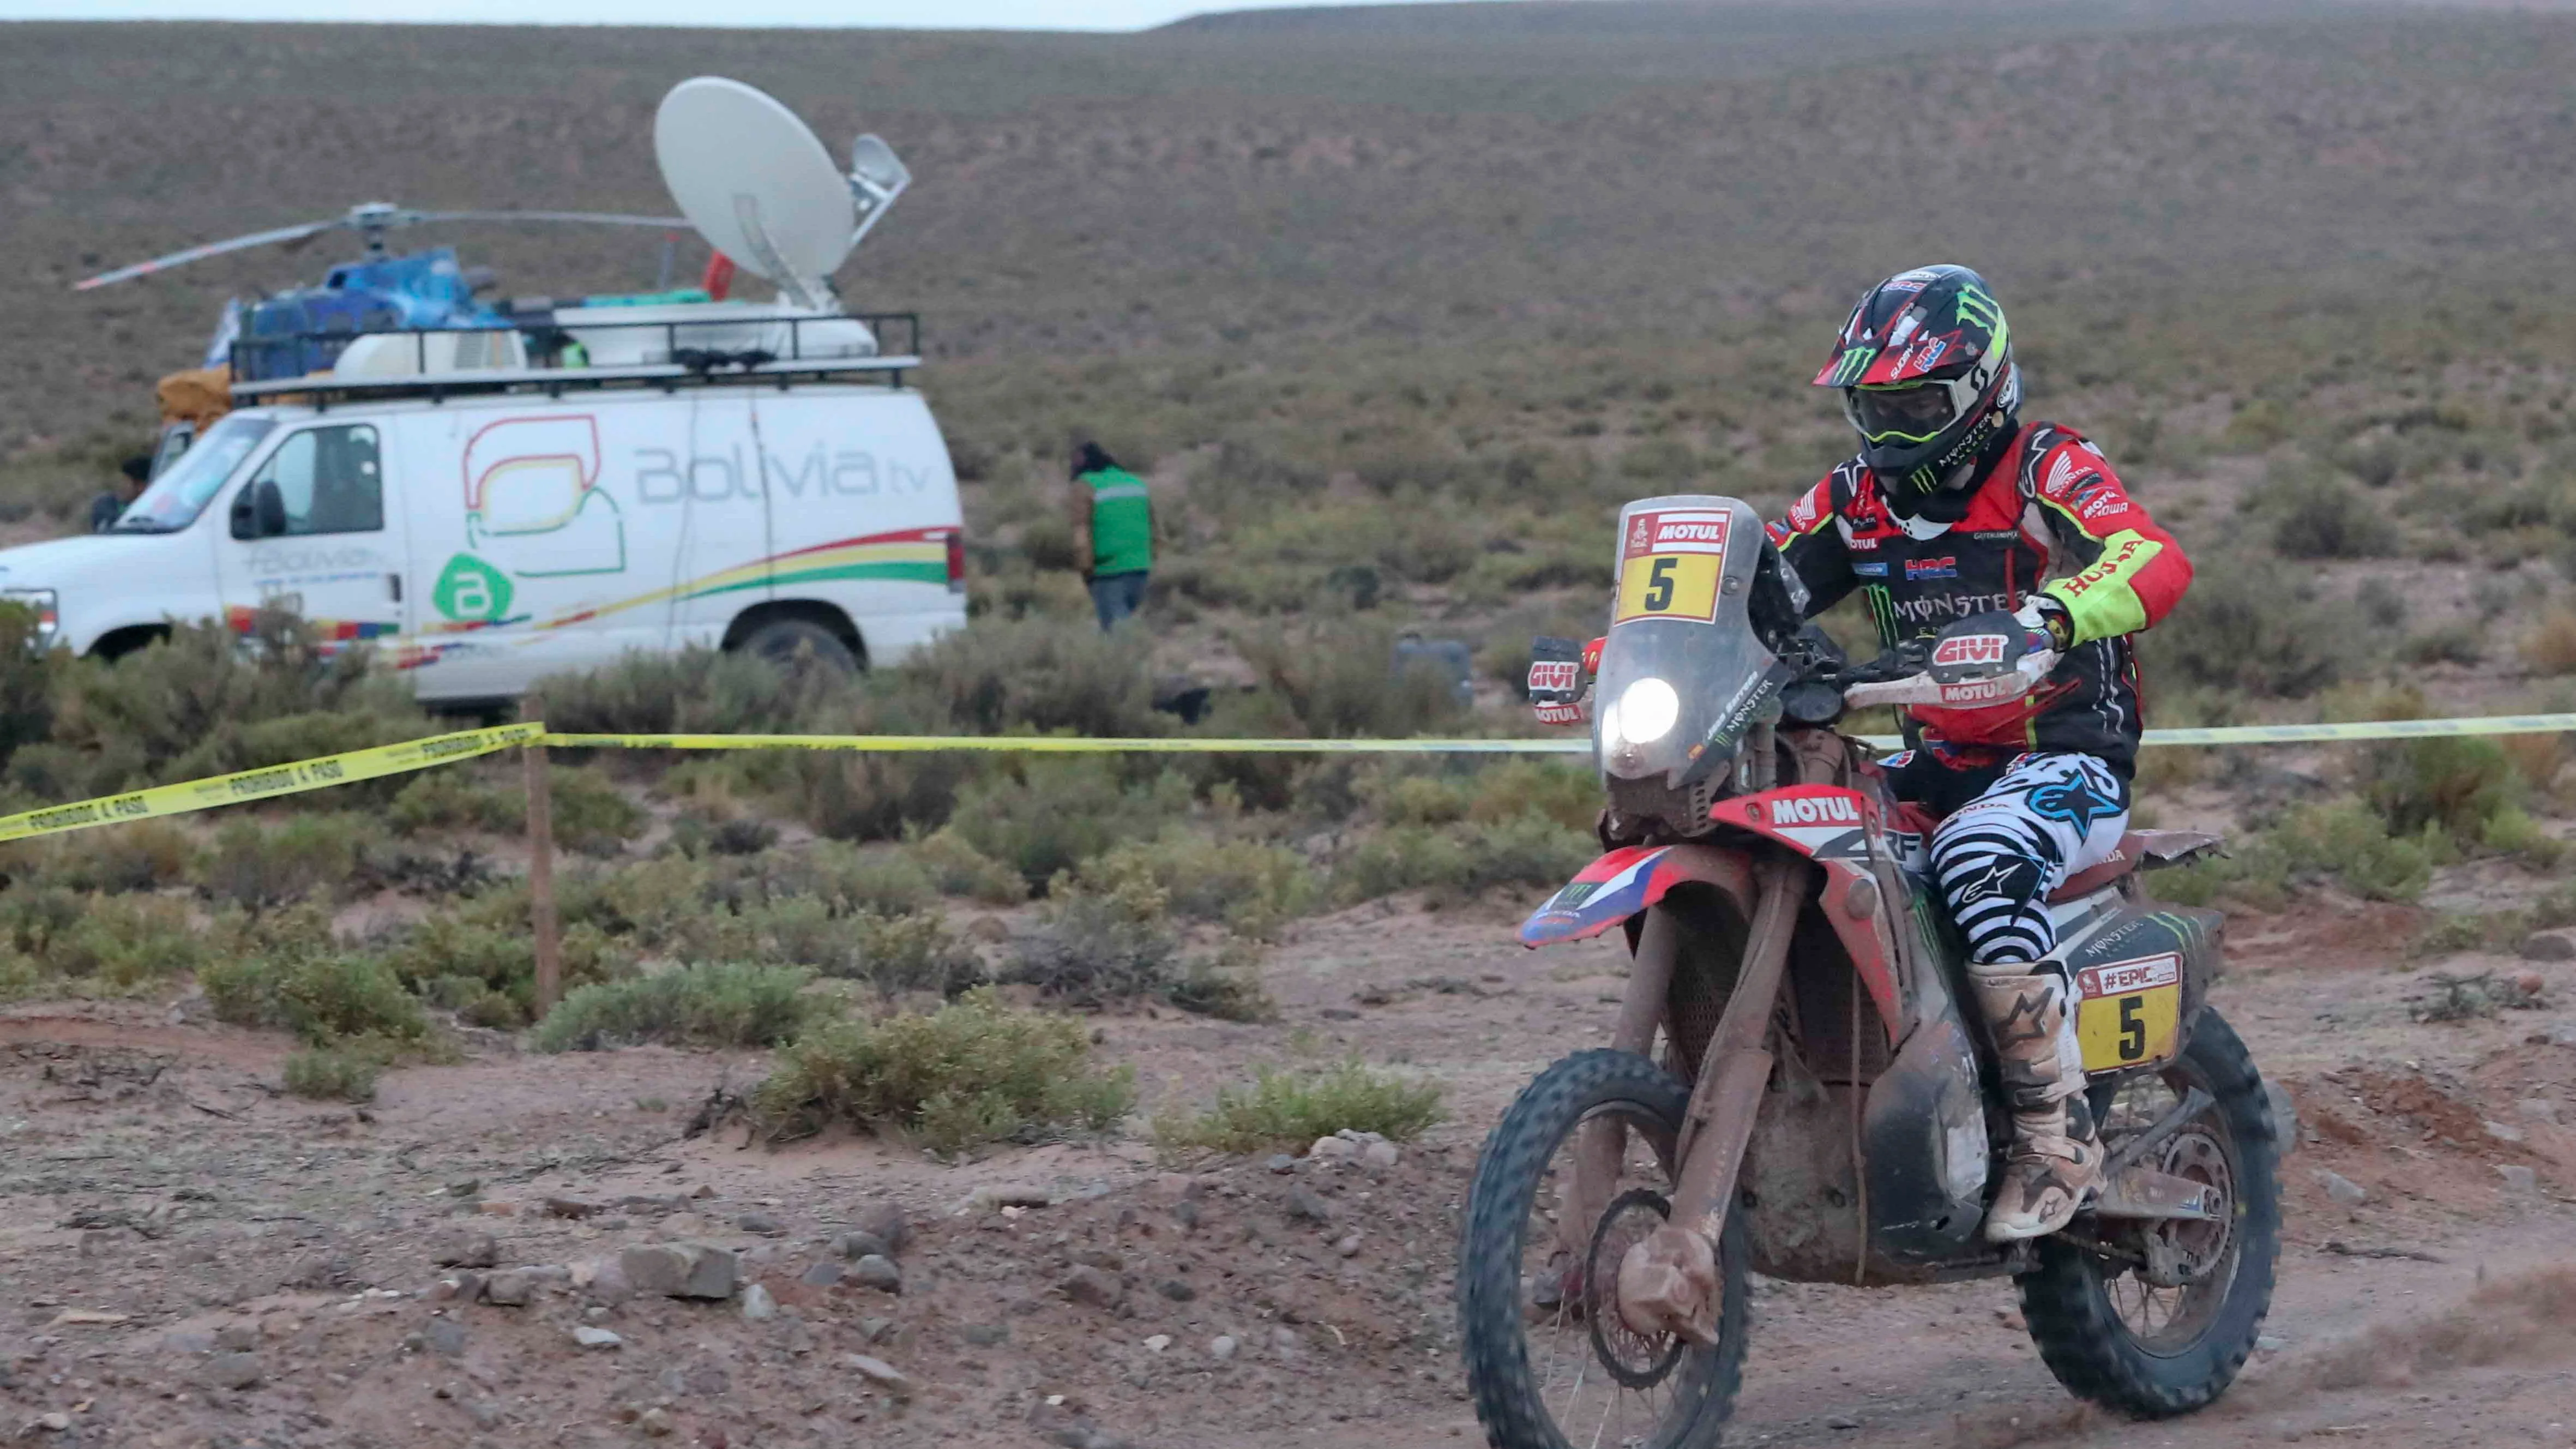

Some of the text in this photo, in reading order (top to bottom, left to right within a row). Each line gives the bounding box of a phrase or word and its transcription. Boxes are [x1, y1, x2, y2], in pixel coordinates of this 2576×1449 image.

[1912, 336, 1947, 373] HRC
[2092, 502, 2128, 518] HOWA
[1658, 524, 1719, 540] MOTUL
[1850, 538, 1877, 550] OTUL
[1905, 556, 1958, 581] HRC
[1645, 557, 1678, 611] 5
[1935, 638, 2001, 664] GIVI
[1529, 664, 1574, 688] GIVI
[1943, 683, 2006, 702] MOTUL
[1726, 679, 1773, 732] MONSTER
[1772, 797, 1859, 824] MOTUL
[2118, 995, 2146, 1061] 5
